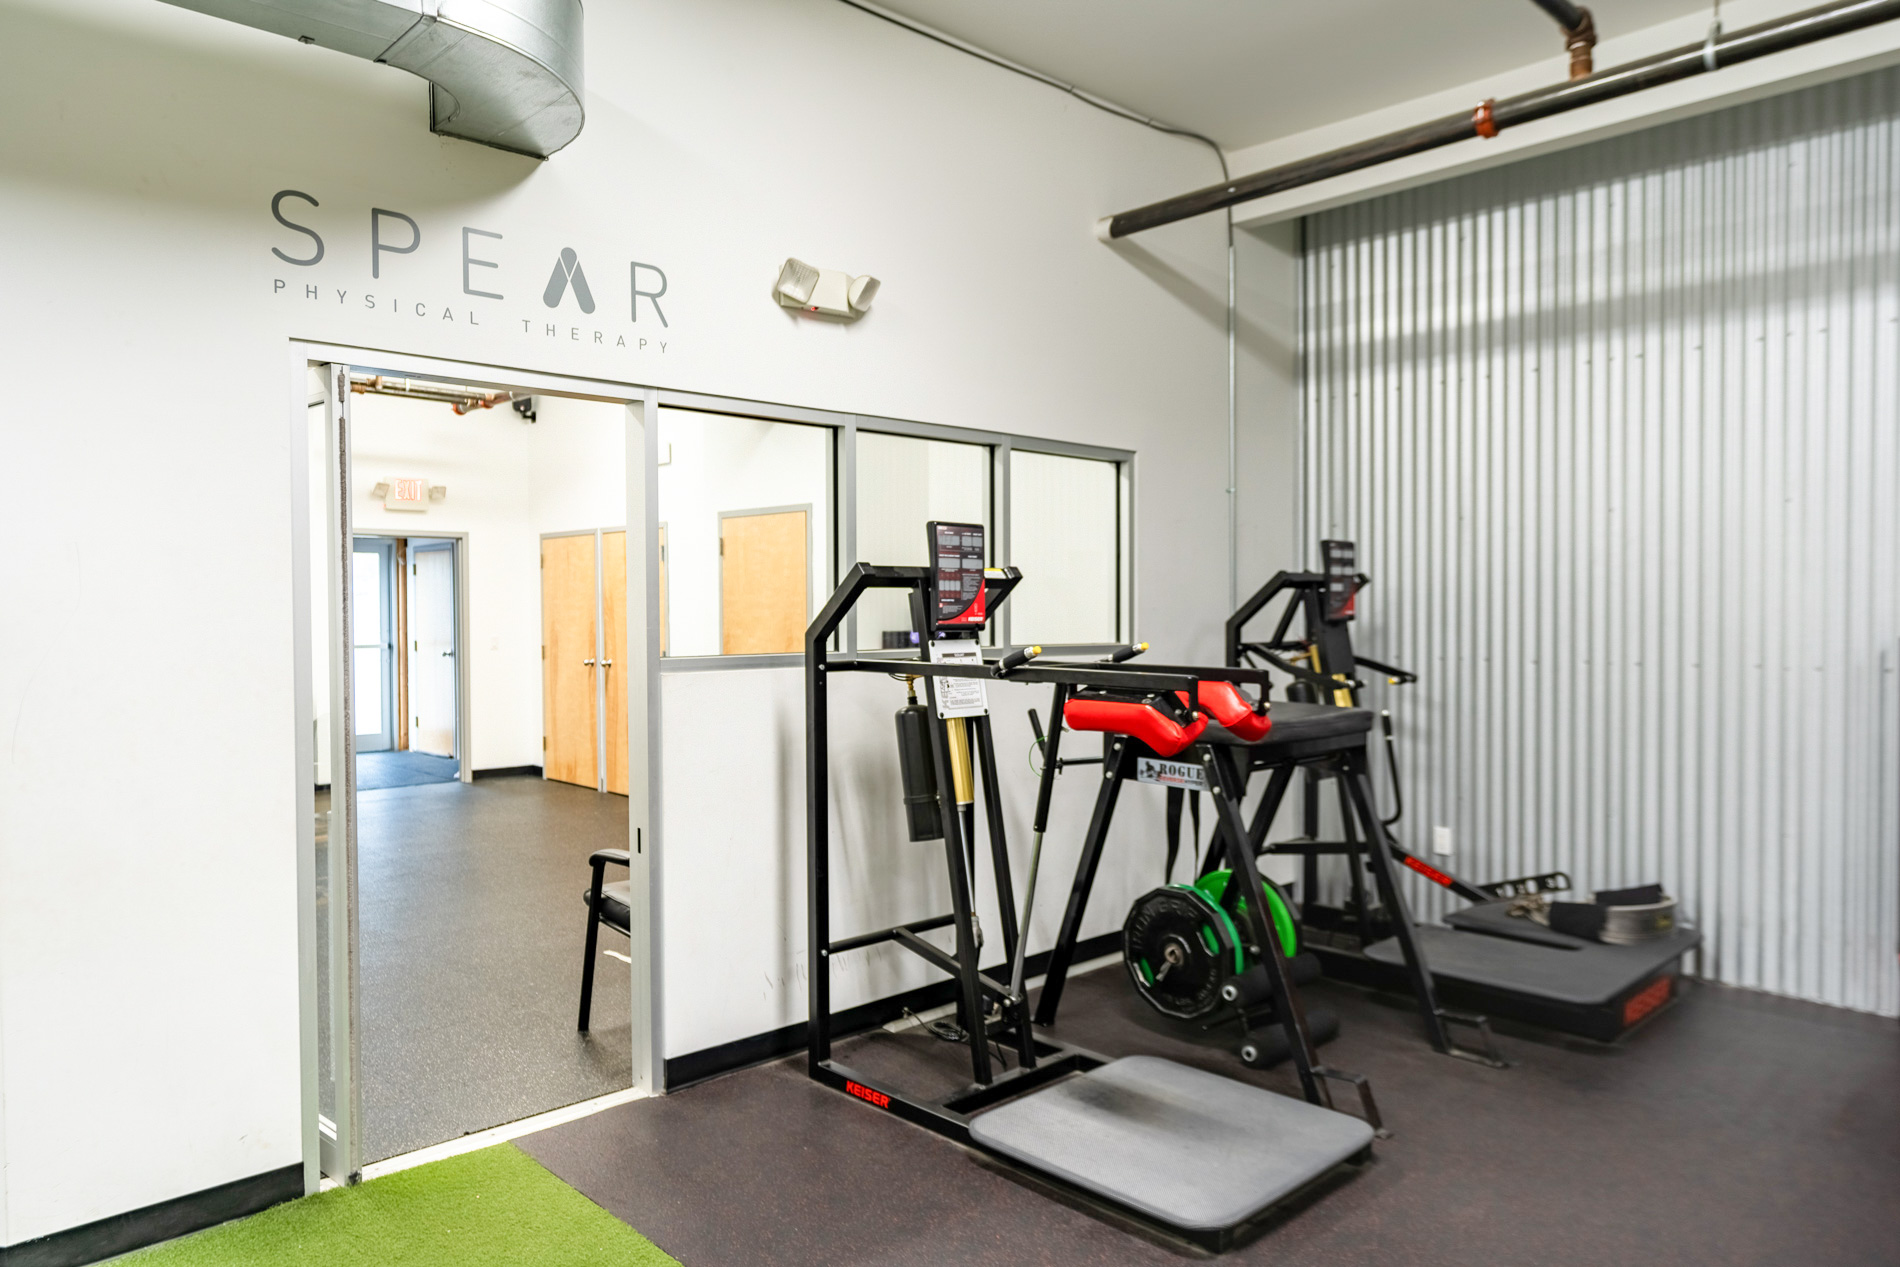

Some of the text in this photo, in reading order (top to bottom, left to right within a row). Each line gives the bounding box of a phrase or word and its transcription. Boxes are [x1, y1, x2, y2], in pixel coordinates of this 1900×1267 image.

[271, 189, 669, 329] SPEAR
[273, 278, 668, 354] PHYSICAL THERAPY
[394, 479, 422, 501] EXIT
[1159, 763, 1204, 780] ROGUE
[846, 1080, 890, 1109] KEISER
